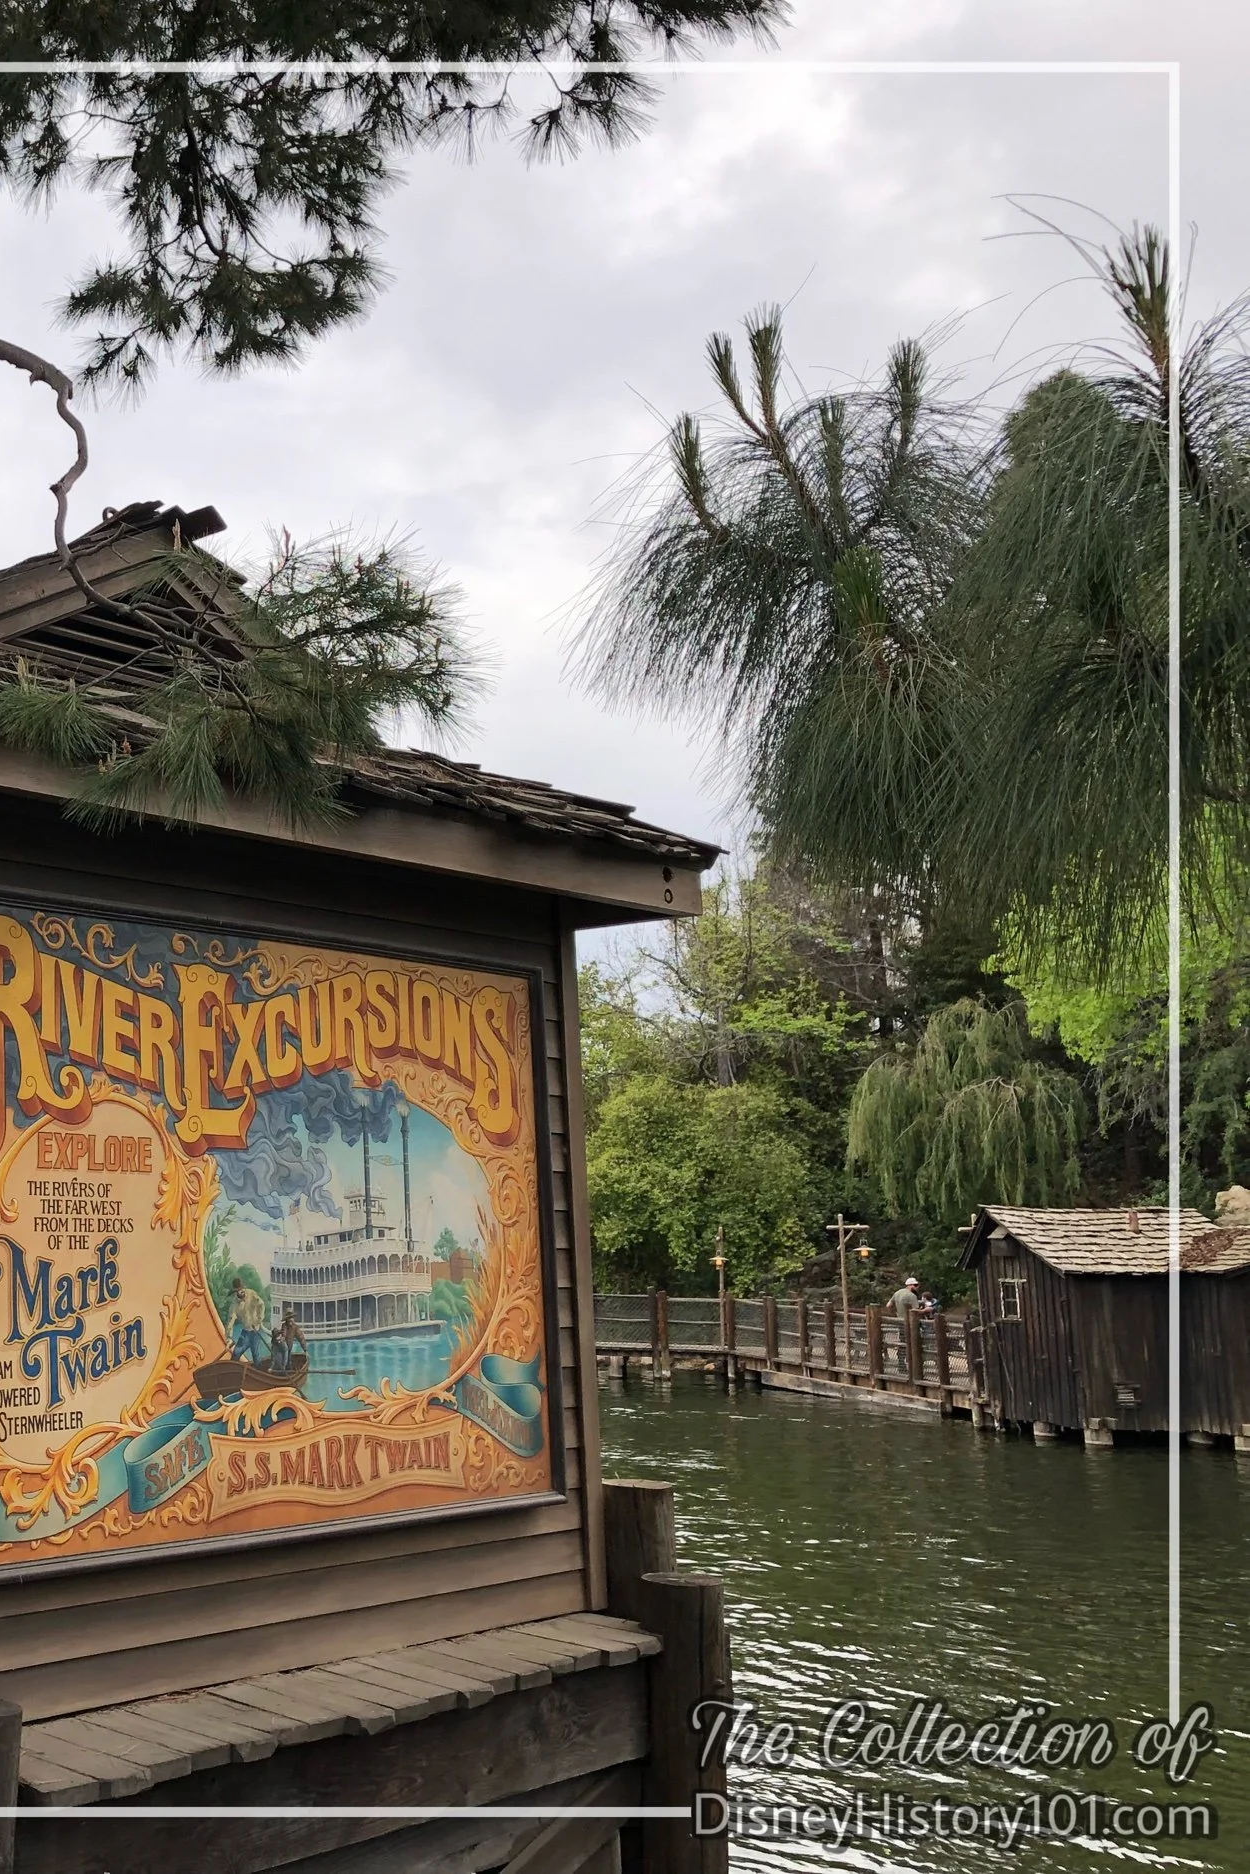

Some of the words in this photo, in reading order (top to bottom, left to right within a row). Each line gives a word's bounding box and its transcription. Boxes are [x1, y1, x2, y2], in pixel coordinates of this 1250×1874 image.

[171, 963, 522, 1158] EXCURSIONS
[37, 1131, 153, 1173] EXPLORE
[27, 1180, 50, 1197] THE
[52, 1177, 95, 1198] RIVERS
[97, 1183, 112, 1198] OF
[40, 1199, 64, 1215] THE
[65, 1199, 89, 1216] FAR
[89, 1200, 122, 1216] WEST
[33, 1217, 69, 1233] FROM
[71, 1217, 94, 1233] THE
[97, 1218, 134, 1234] DECKS
[47, 1235, 64, 1250] OF
[66, 1235, 89, 1250] THE
[18, 1311, 148, 1413] Twain
[143, 1428, 209, 1501] SAFE
[279, 1433, 364, 1491] MARK
[365, 1430, 452, 1480] TWAIN
